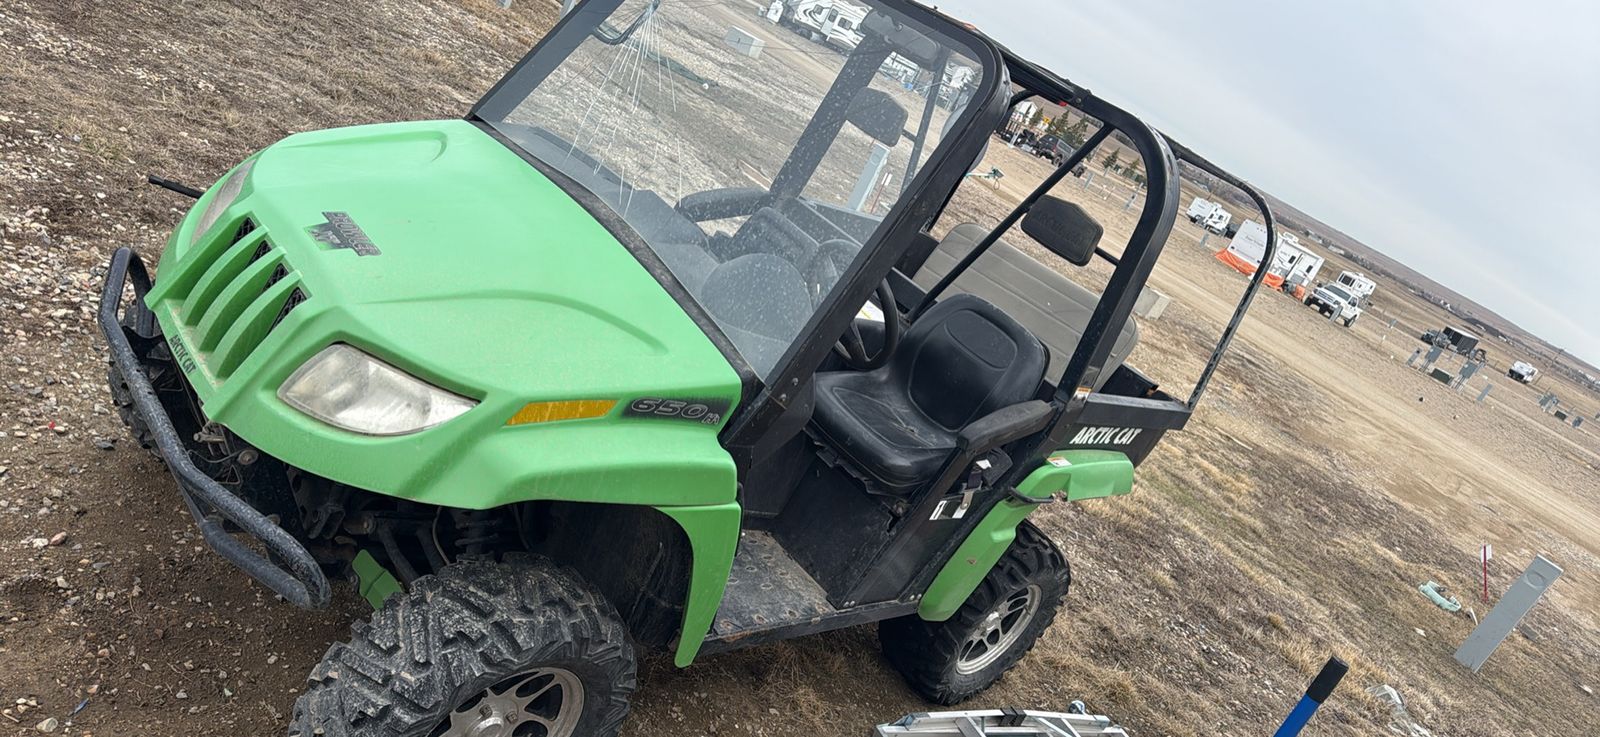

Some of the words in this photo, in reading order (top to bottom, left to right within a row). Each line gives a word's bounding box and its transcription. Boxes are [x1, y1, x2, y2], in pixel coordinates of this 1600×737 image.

[169, 335, 189, 361] ARCTIC
[182, 358, 196, 375] CAT
[631, 397, 708, 418] 650
[1069, 426, 1120, 445] ARCTIC
[1113, 427, 1143, 445] CAT
